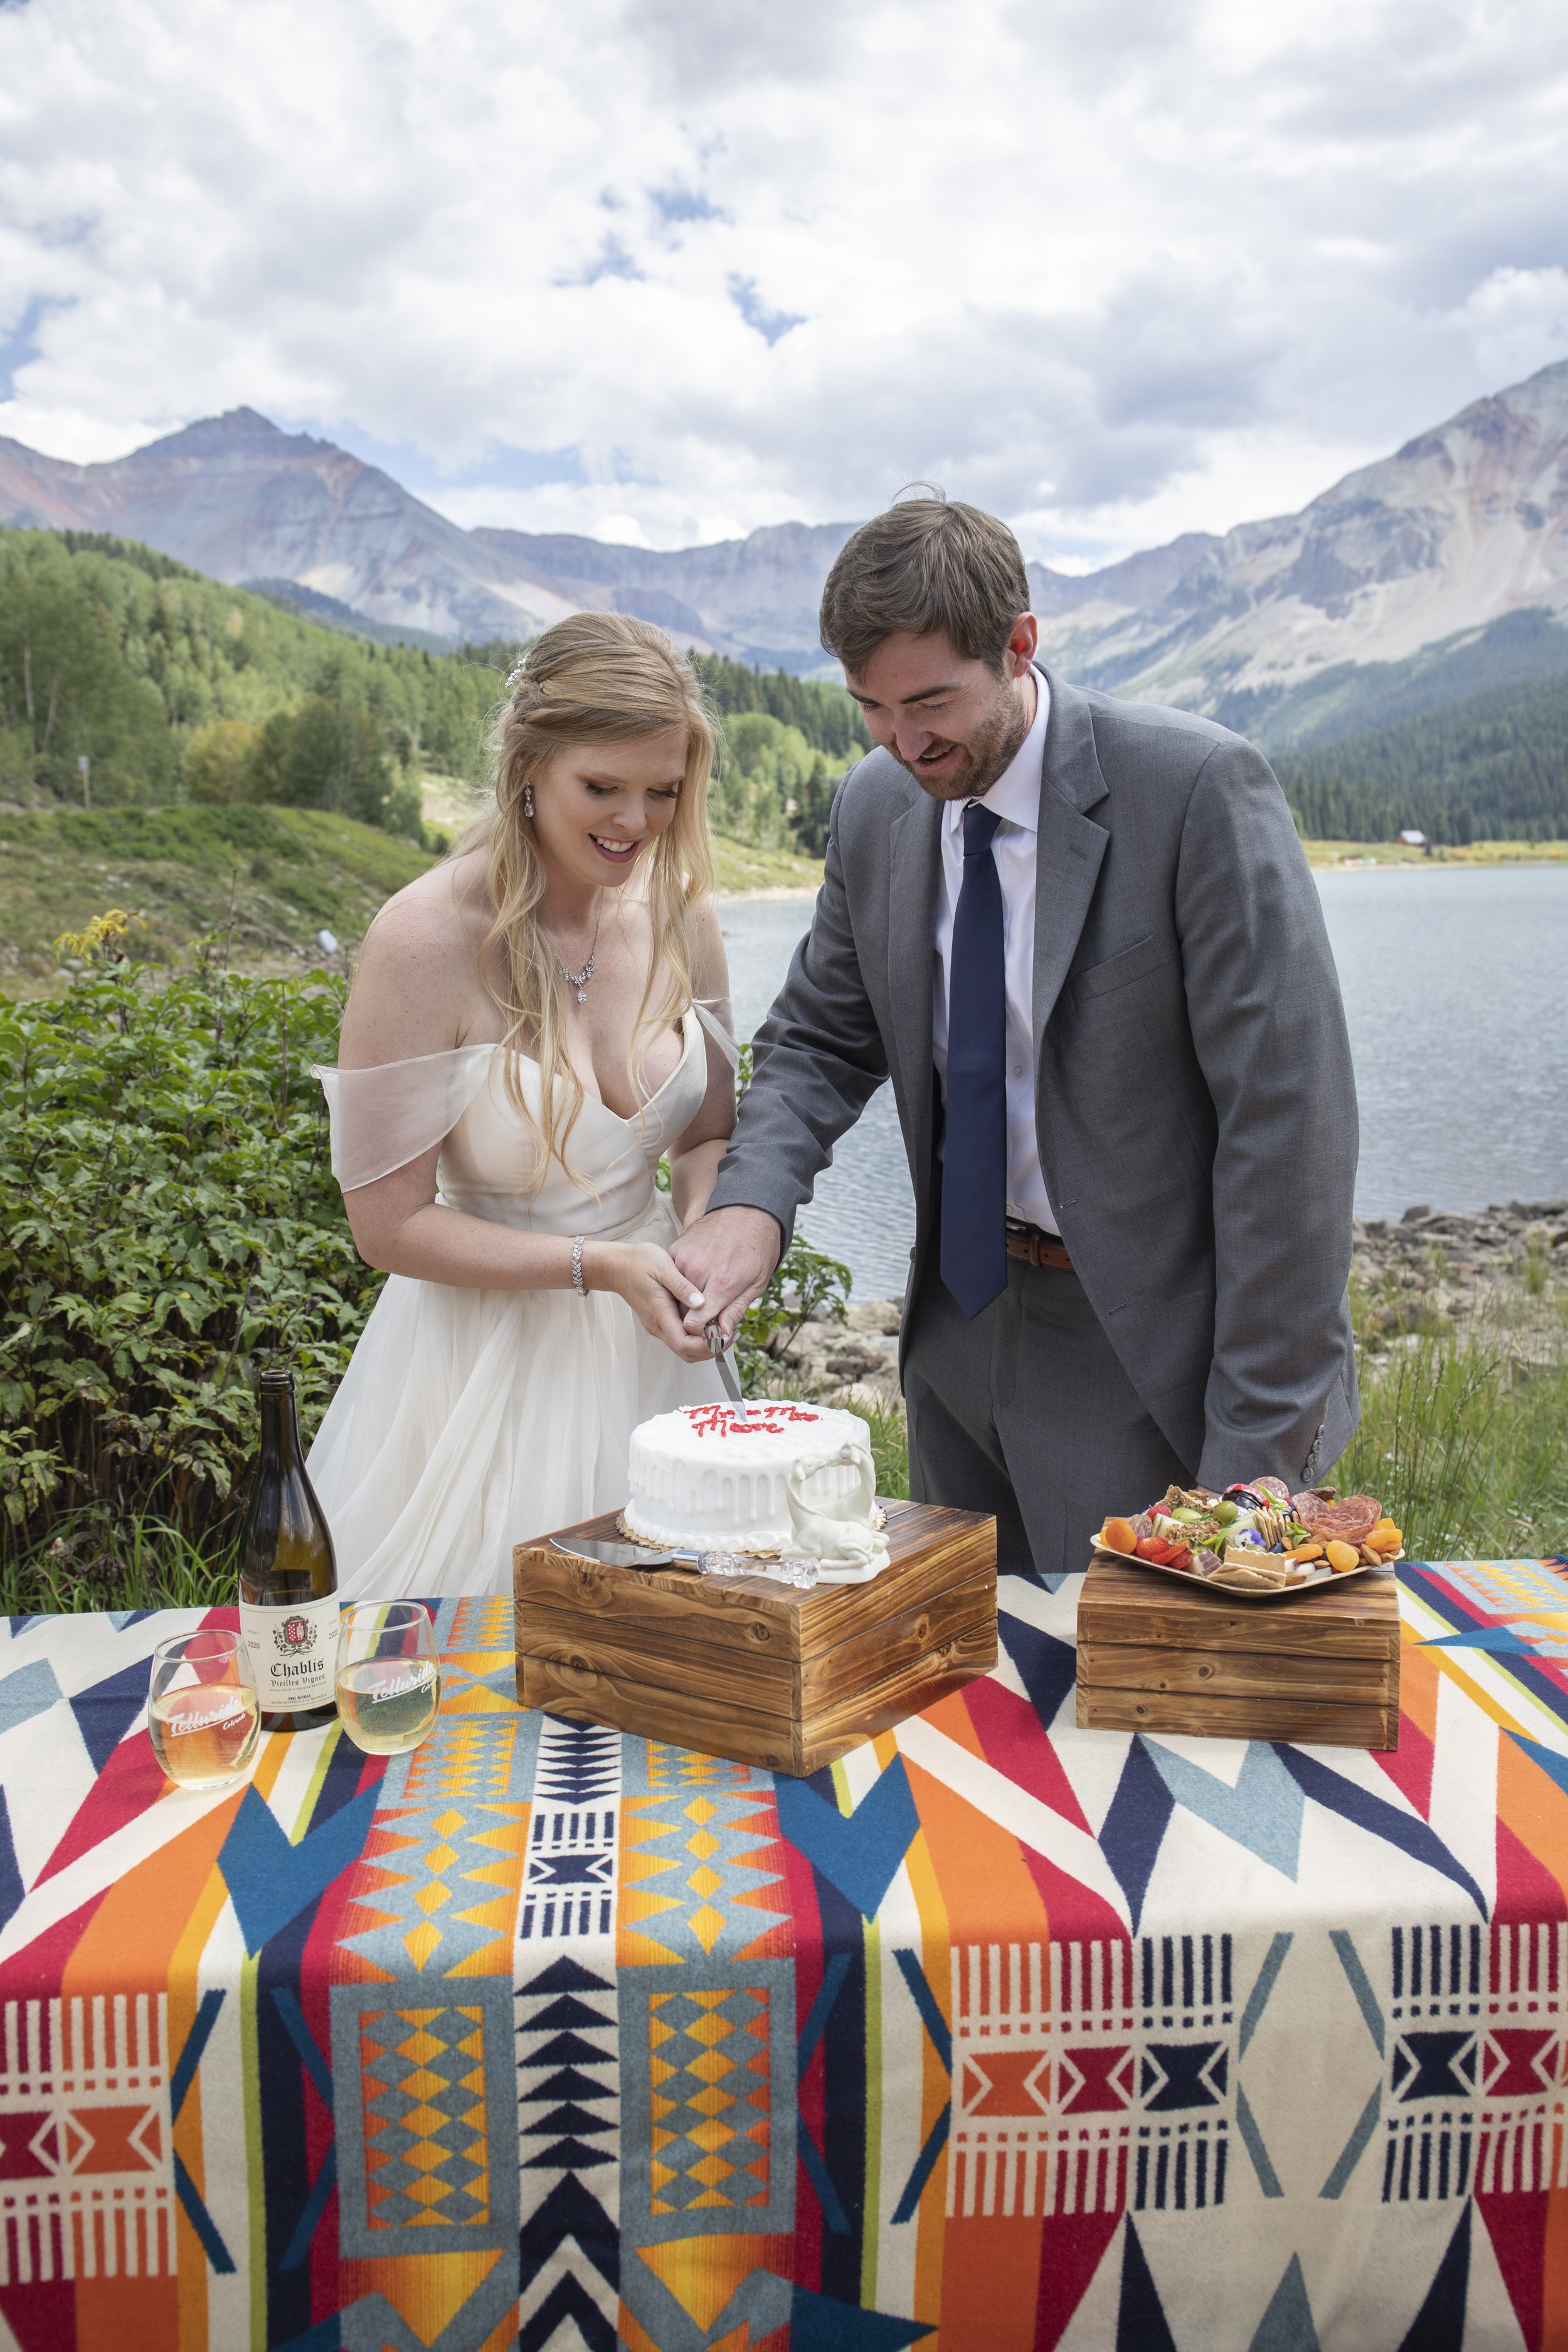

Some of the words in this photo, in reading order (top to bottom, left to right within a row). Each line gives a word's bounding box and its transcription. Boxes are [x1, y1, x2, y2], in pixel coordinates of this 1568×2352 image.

[692, 1419, 784, 1437] Moore
[329, 1629, 338, 1640] 2020
[248, 1641, 260, 1649] 2020
[271, 1658, 324, 1679] Chablis
[302, 1674, 325, 1684] Vignes
[368, 1660, 435, 1700] Telluride
[166, 1695, 241, 1734] Telluride
[223, 1713, 246, 1730] Colorado
